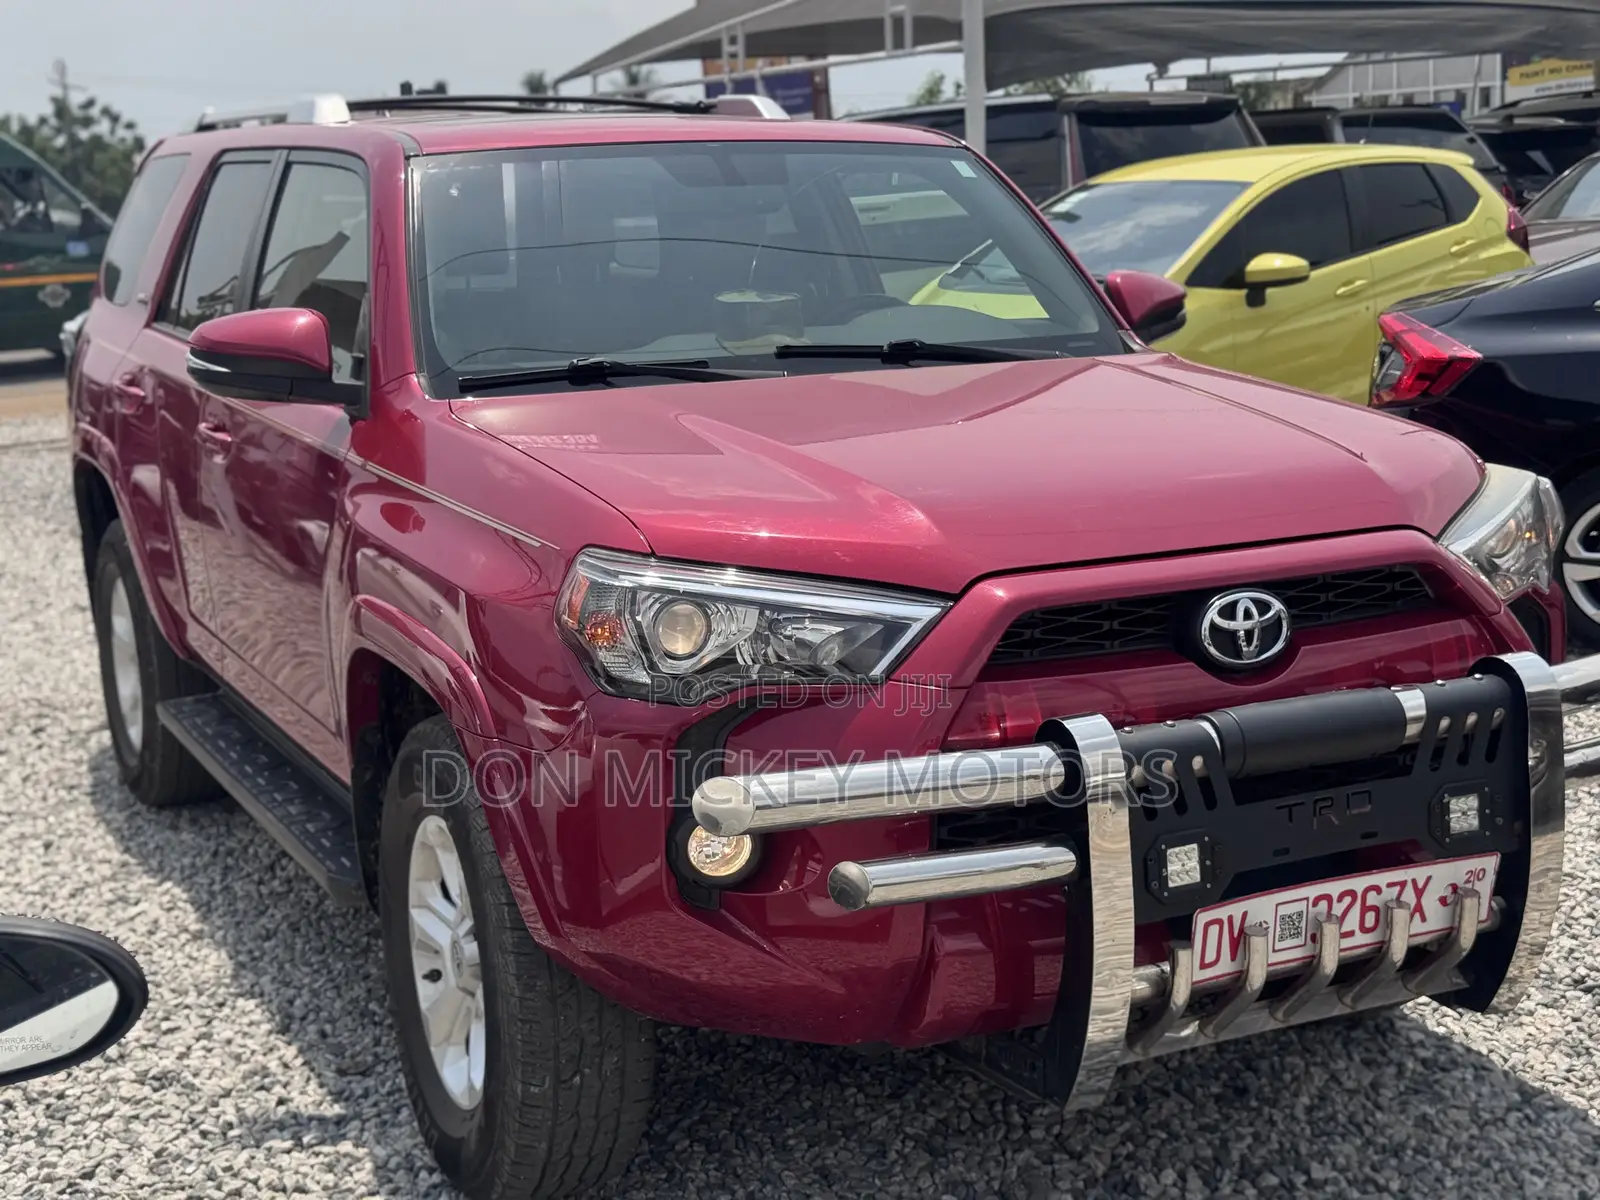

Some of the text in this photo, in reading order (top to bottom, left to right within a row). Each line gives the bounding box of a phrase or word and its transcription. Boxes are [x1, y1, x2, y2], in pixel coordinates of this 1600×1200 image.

[1275, 789, 1372, 830] TRD
[1199, 910, 1249, 970] DV
[0, 1042, 52, 1054] THEY APPEAR
